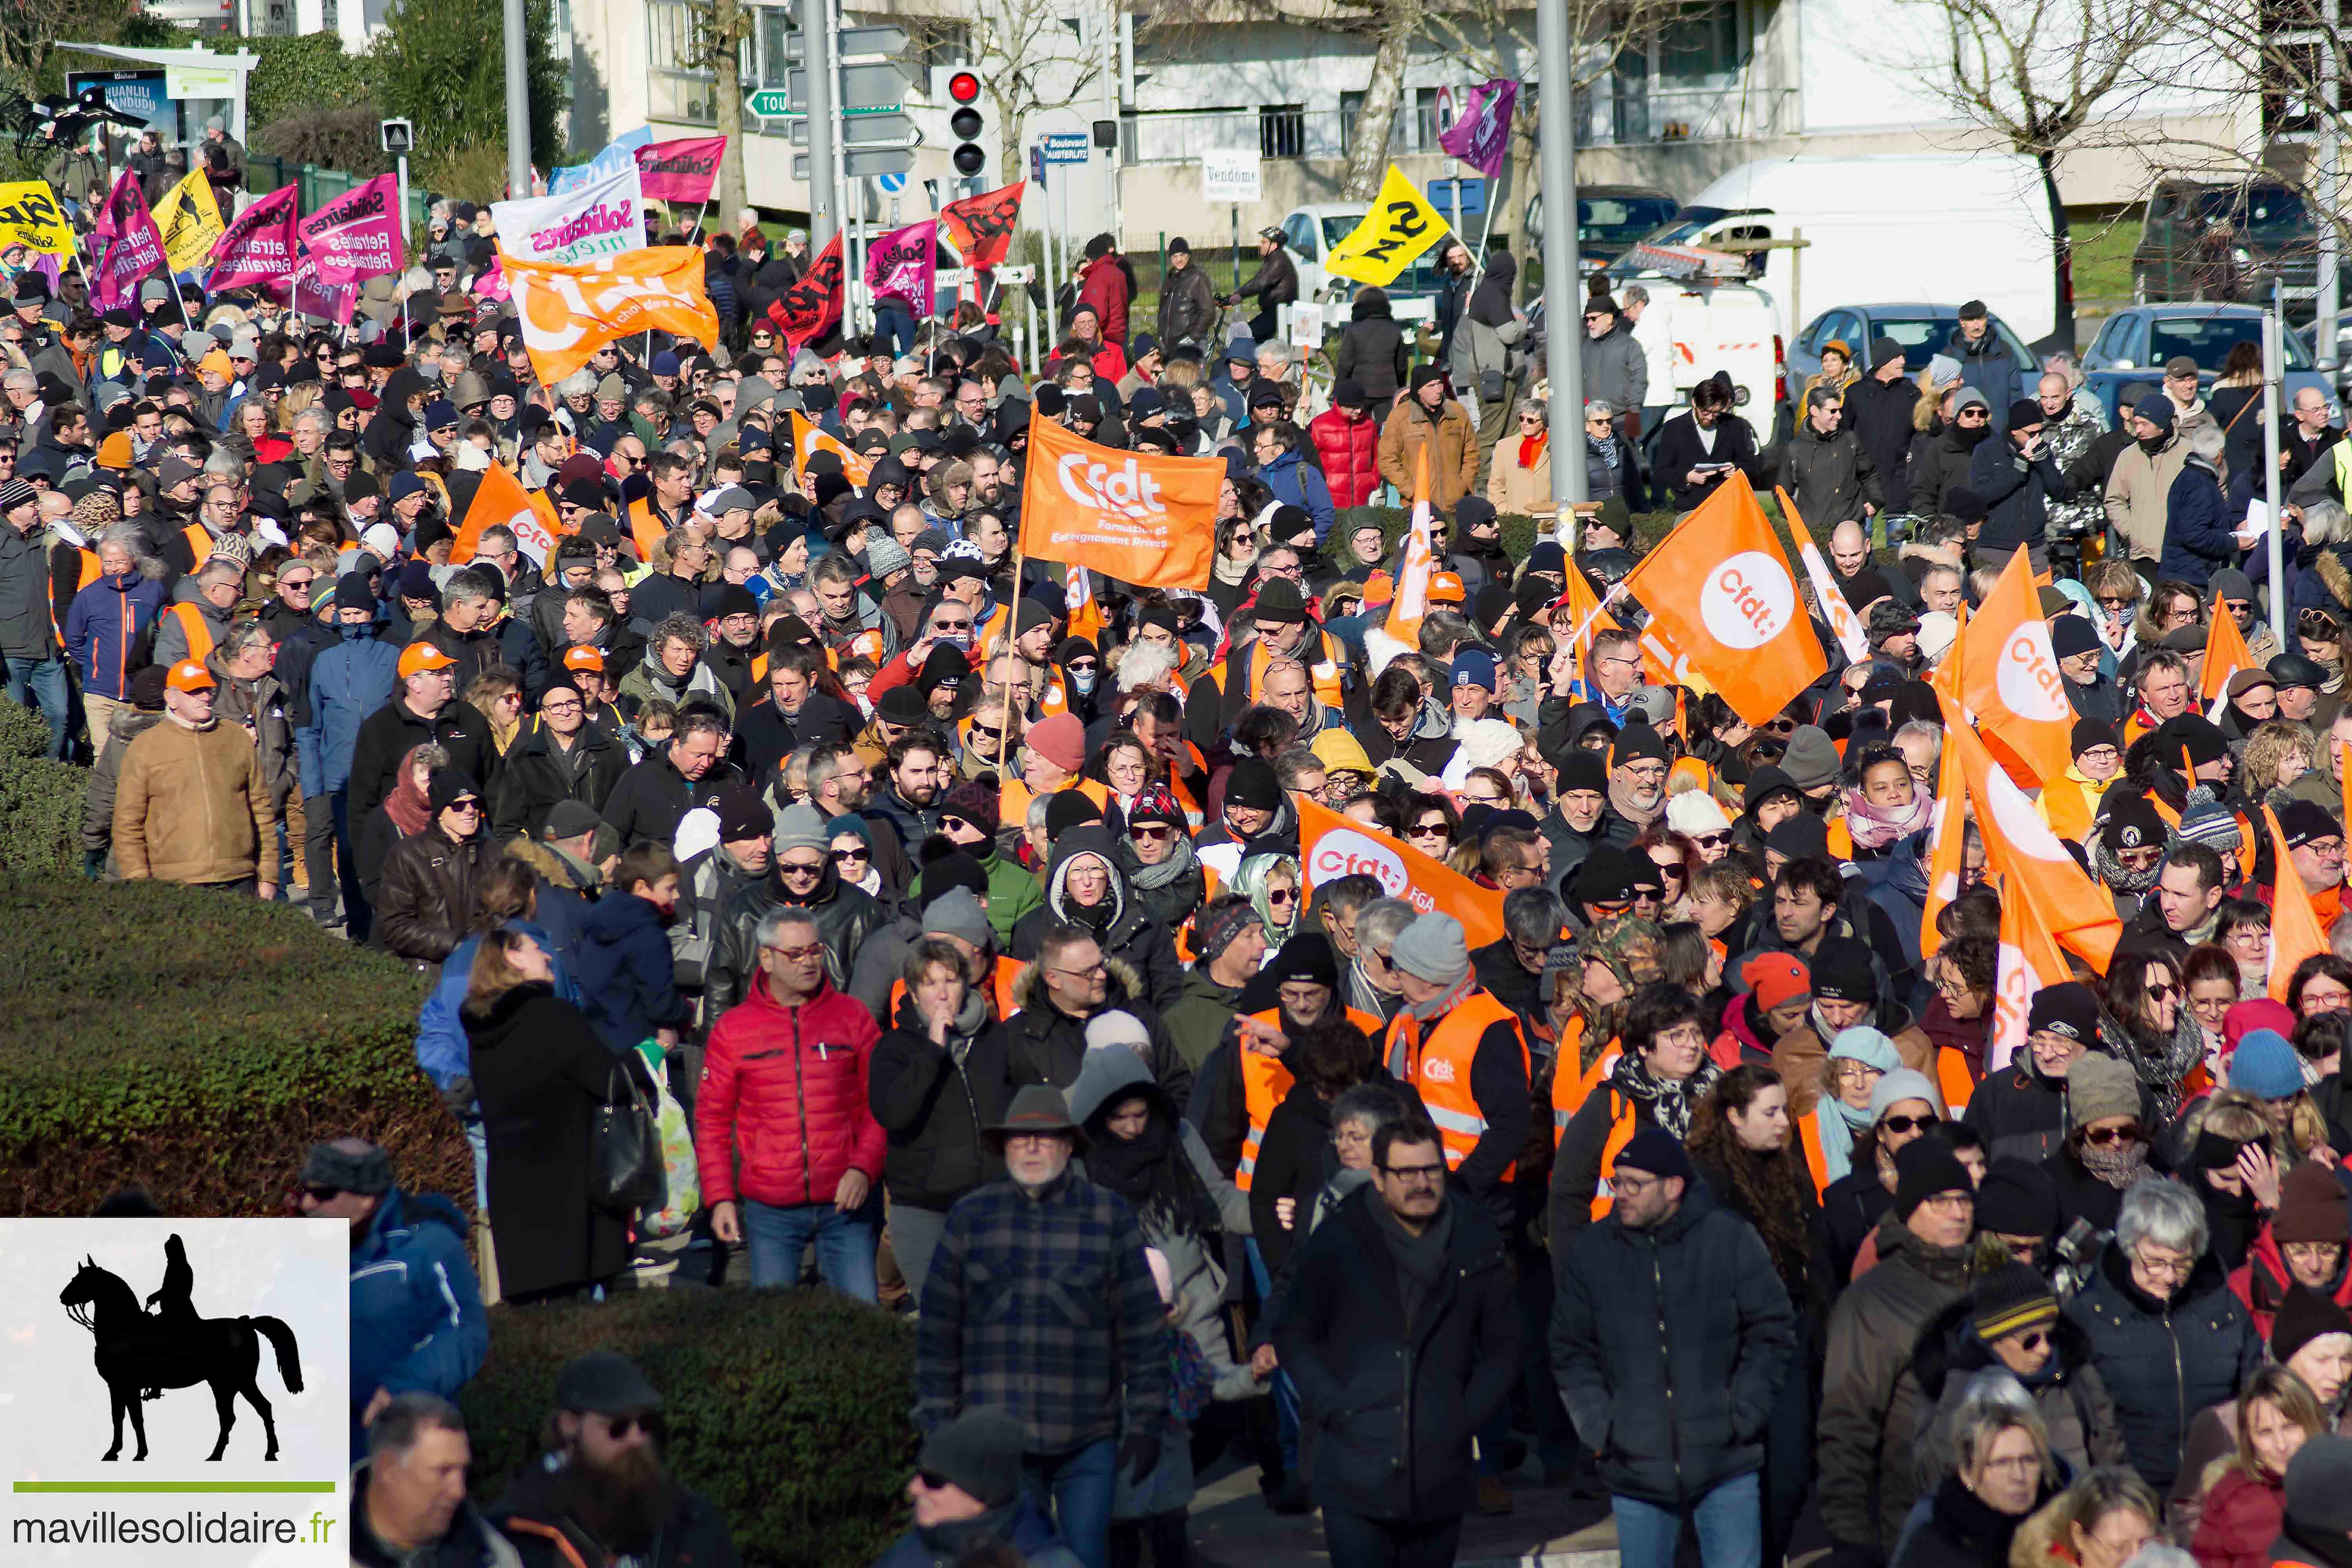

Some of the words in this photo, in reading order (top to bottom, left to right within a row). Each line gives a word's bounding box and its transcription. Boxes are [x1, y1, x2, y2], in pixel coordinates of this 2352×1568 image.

[762, 96, 788, 111] TOU
[1051, 138, 1087, 148] Boulevard
[1207, 166, 1258, 183] Vendôme
[1057, 454, 1167, 512] Cfdt
[1052, 532, 1129, 545] Enseignement
[1408, 885, 1435, 913] FGA
[1423, 1058, 1455, 1081] Cfdt
